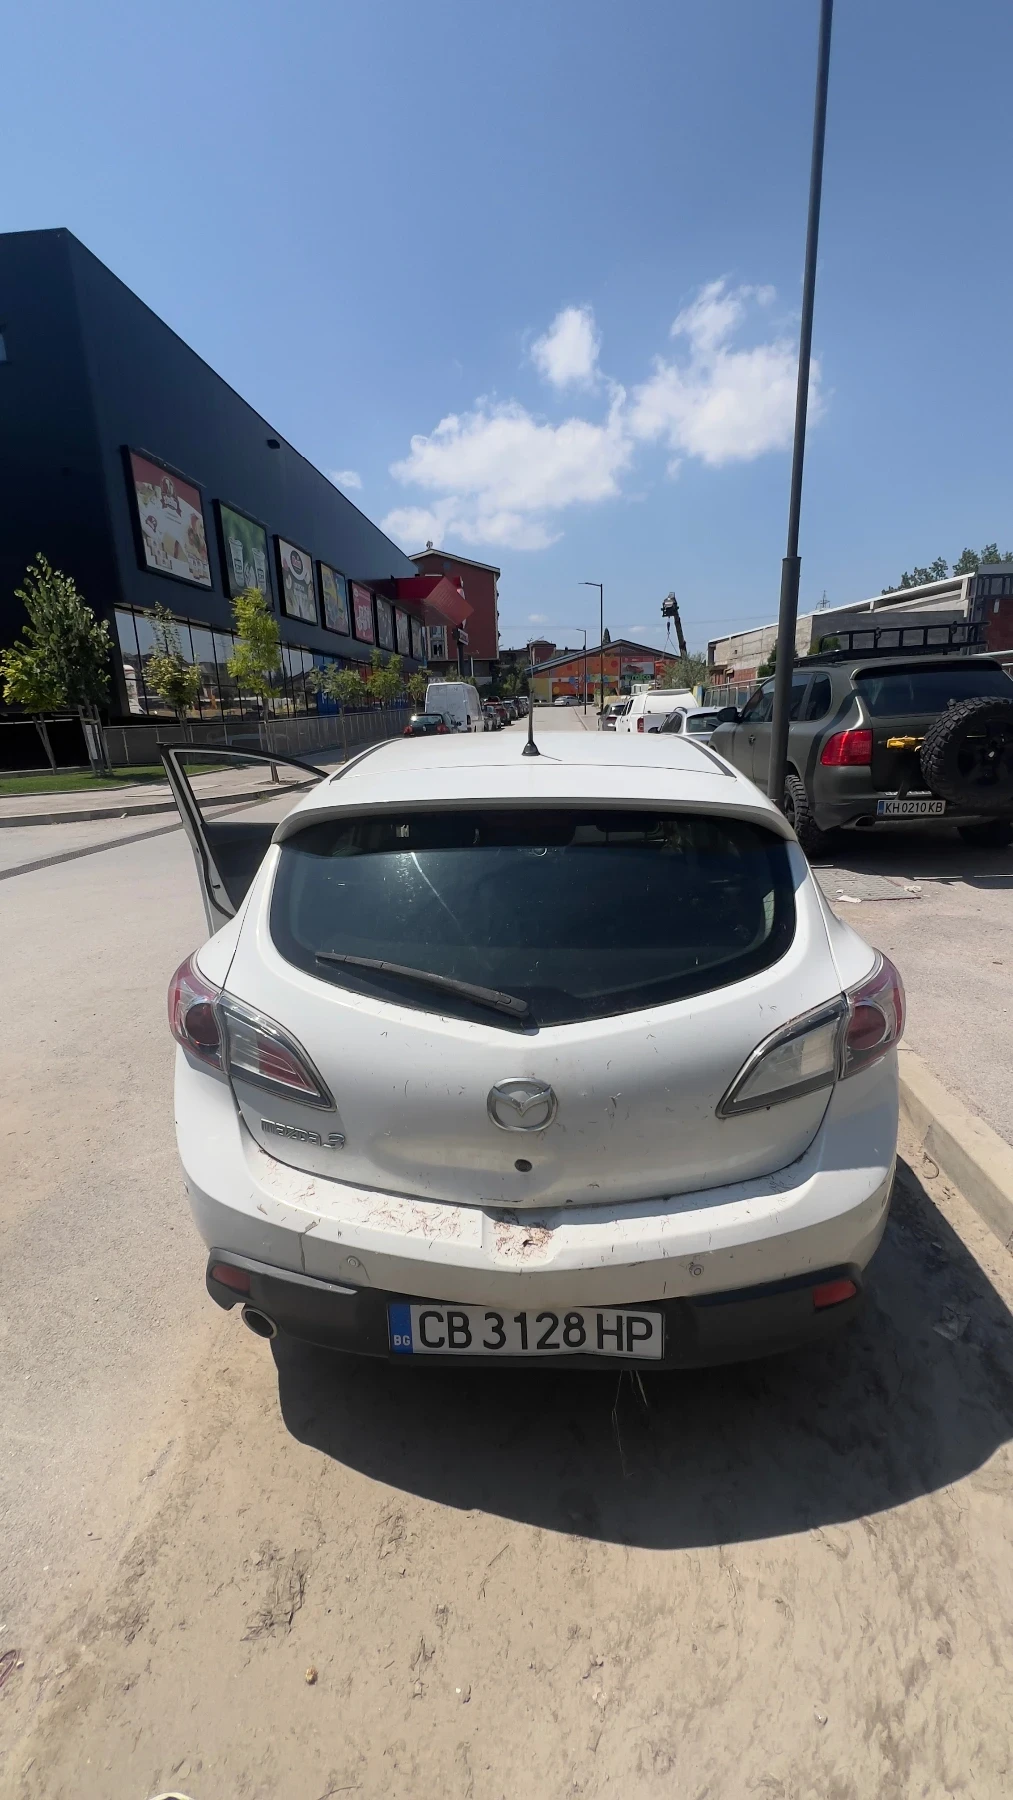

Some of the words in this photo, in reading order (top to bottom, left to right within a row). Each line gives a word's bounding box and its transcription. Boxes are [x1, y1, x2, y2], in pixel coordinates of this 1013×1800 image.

[885, 802, 900, 813] KH
[901, 802, 927, 813] 0210
[928, 802, 943, 813] KB
[419, 1310, 472, 1348] CB
[483, 1312, 586, 1350] 3128
[596, 1313, 653, 1352] HP
[393, 1335, 410, 1346] BG
